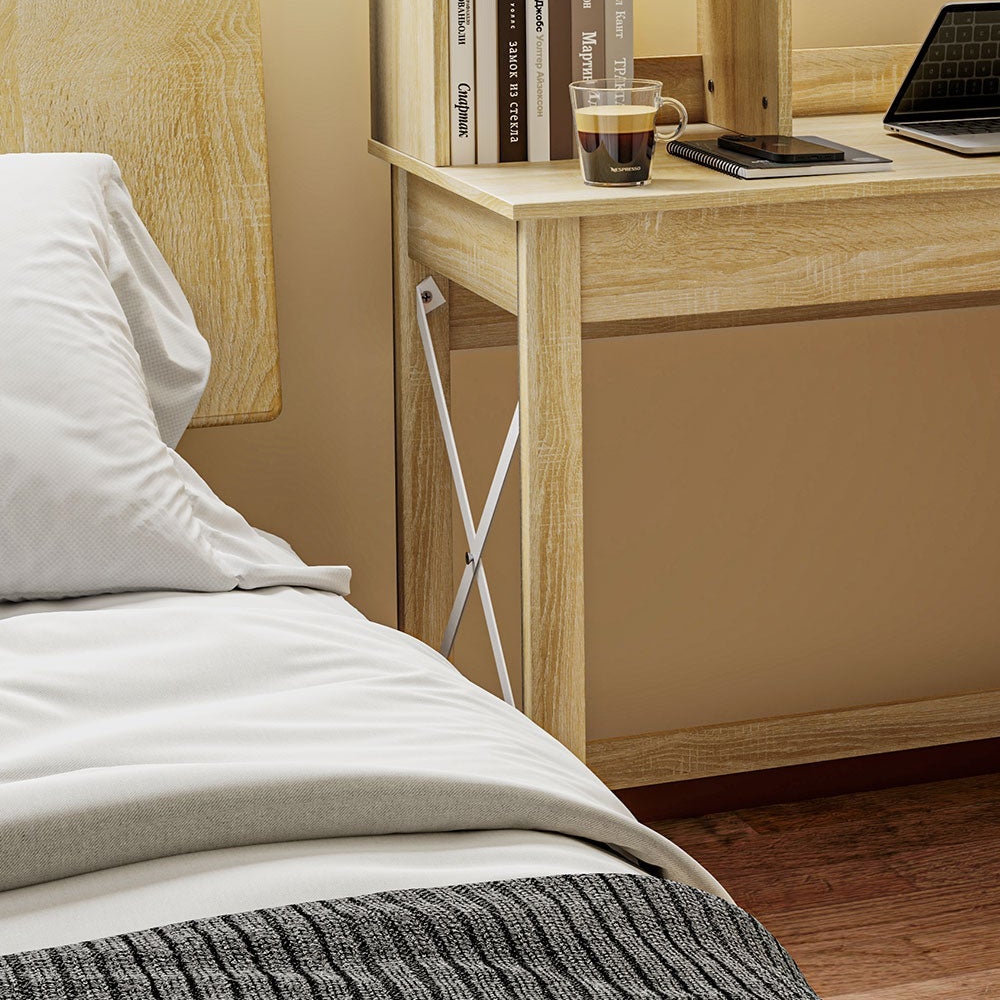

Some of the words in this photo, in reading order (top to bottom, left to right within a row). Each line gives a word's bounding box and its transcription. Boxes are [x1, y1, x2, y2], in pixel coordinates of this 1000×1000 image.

[616, 11, 626, 39] Кант
[509, 41, 518, 79] замок
[534, 33, 544, 69] Уолтер
[509, 83, 518, 98] из
[535, 70, 544, 118] Айзексон
[454, 82, 472, 139] Спартак
[509, 102, 519, 143] стекла
